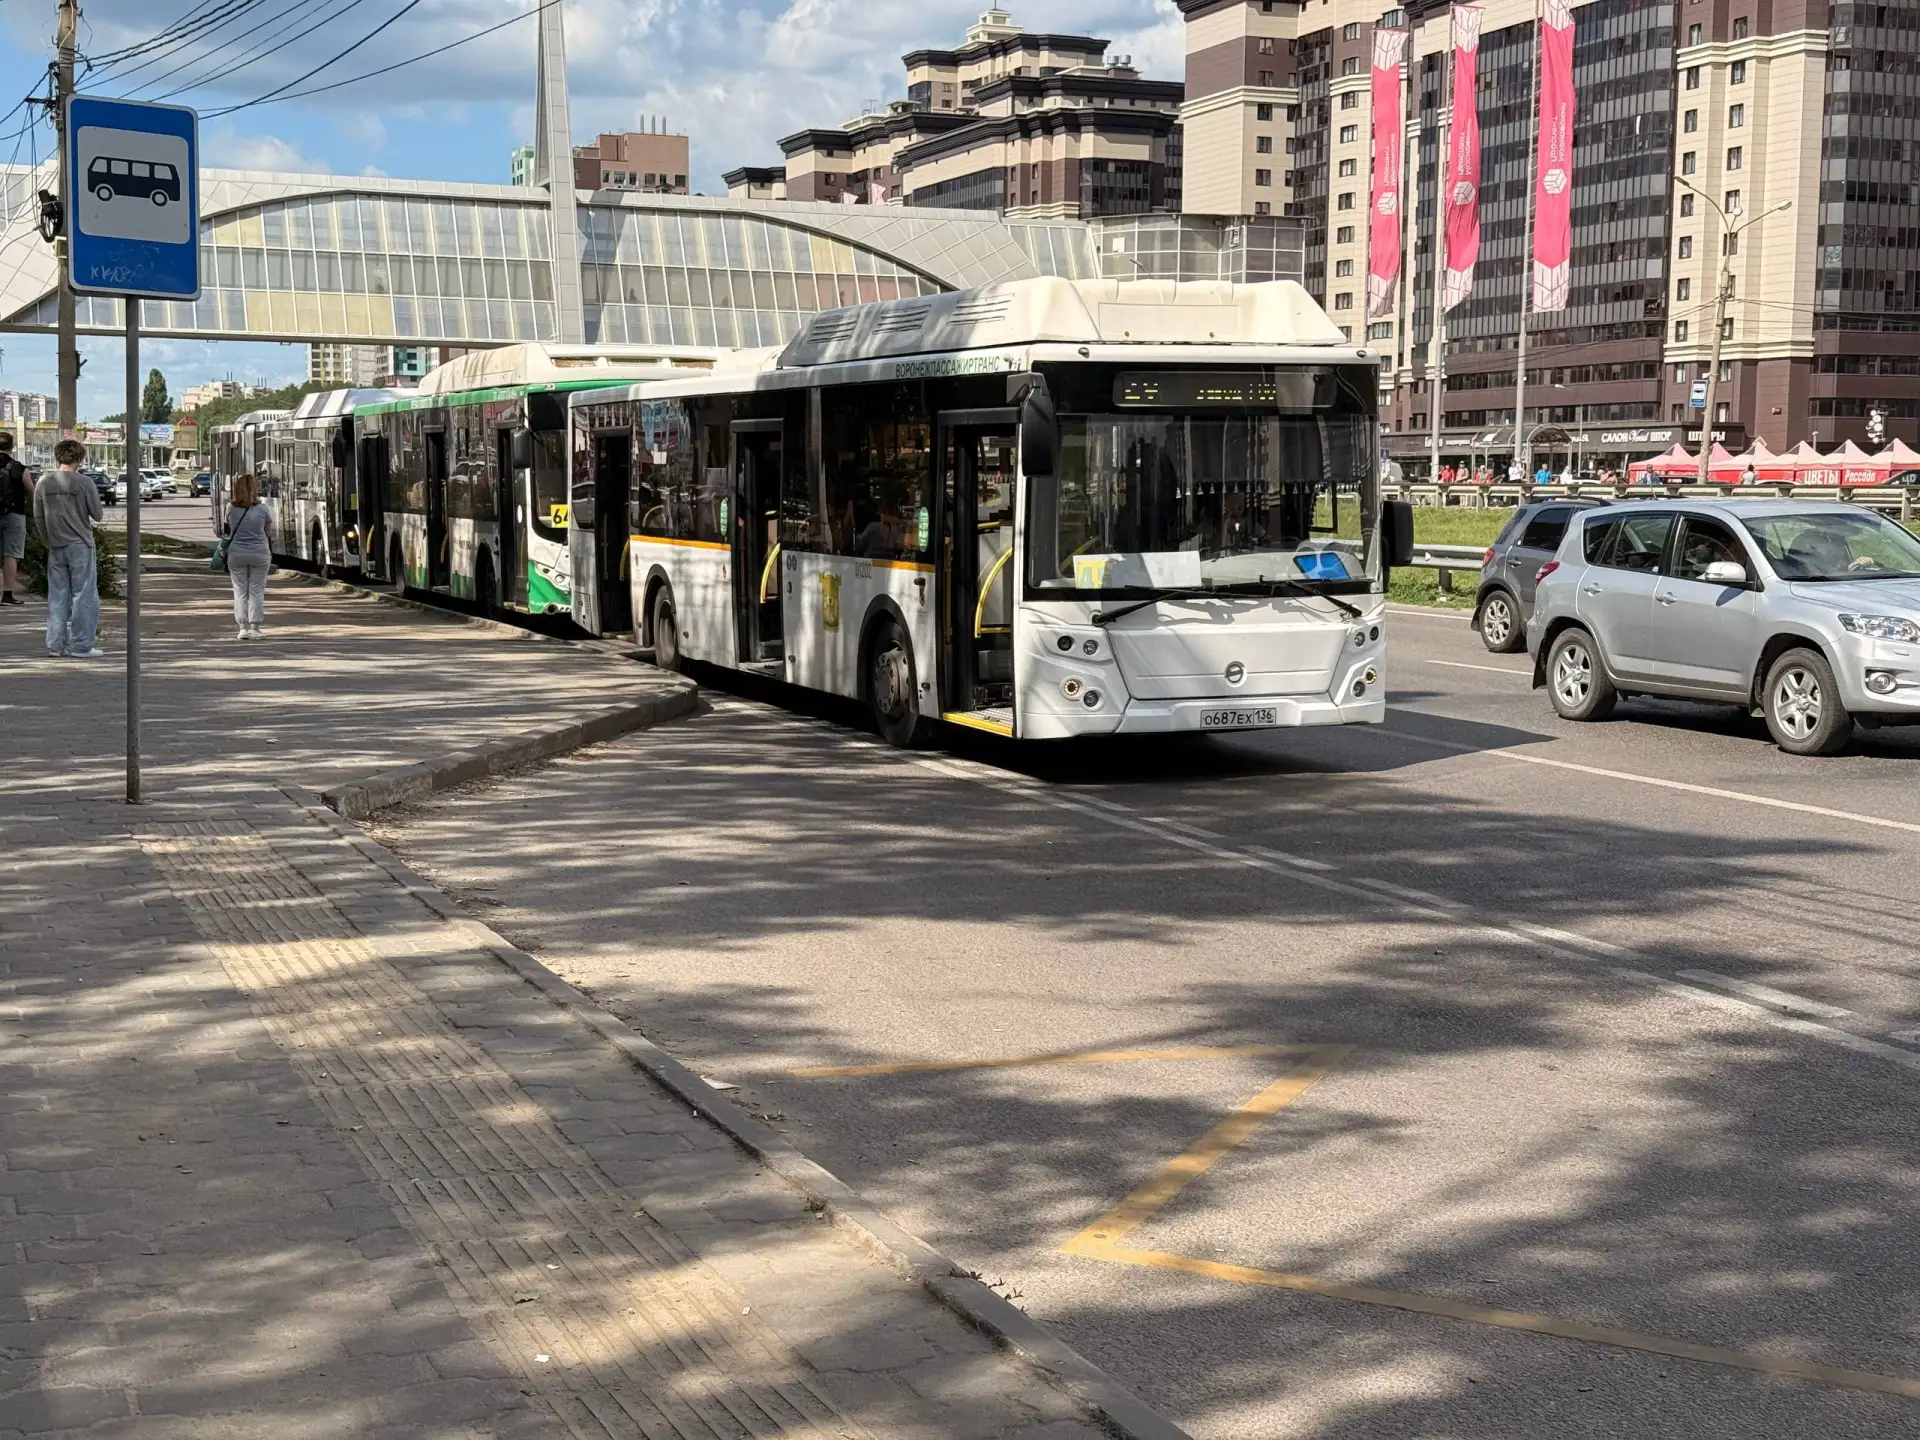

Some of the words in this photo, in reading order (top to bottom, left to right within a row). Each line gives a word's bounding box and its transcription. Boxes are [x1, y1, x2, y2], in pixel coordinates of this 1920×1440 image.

[895, 356, 1000, 378] ВОРОНЕЖПАССАЖИРТРАНС
[1601, 432, 1629, 443] САЛОН
[1650, 431, 1672, 442] ШТОР
[1688, 431, 1726, 442] ШТРЫ
[1804, 469, 1839, 485] ЦВЕТЫ
[1254, 709, 1272, 720] 136
